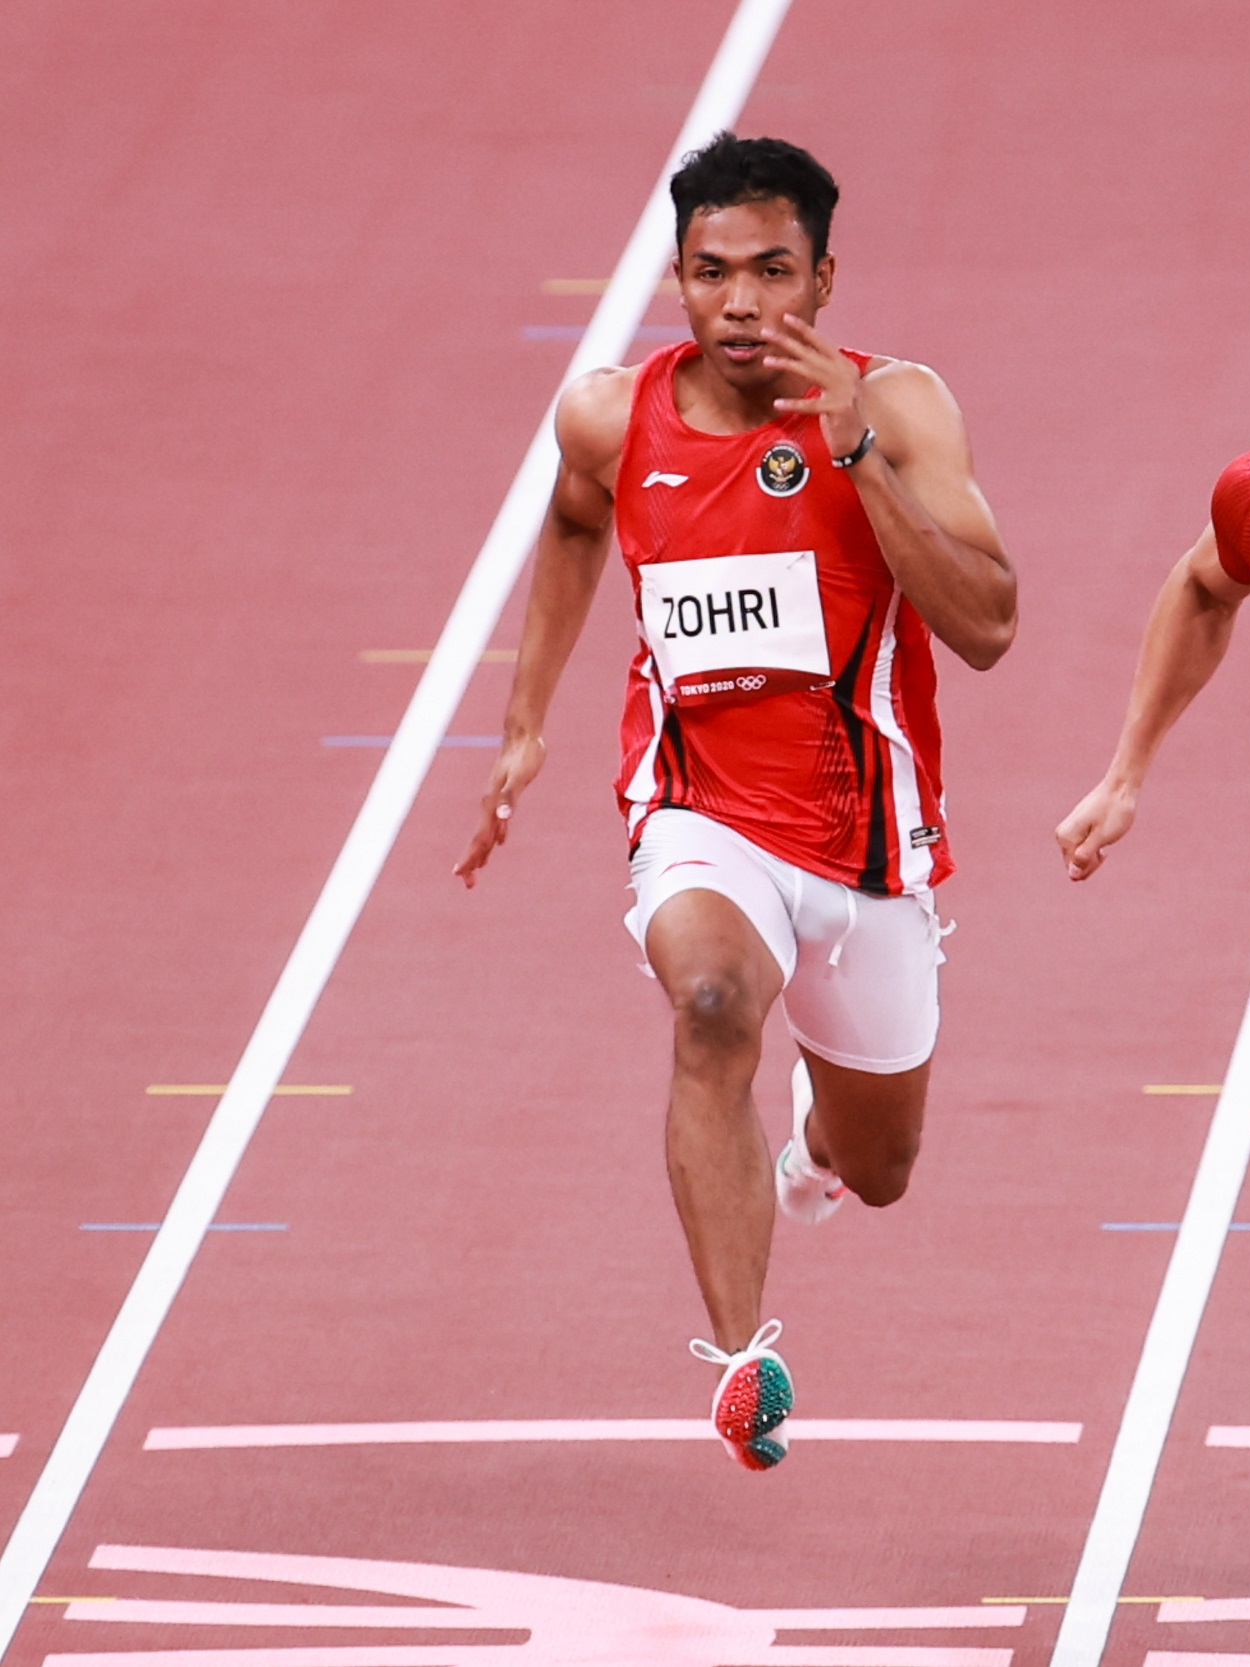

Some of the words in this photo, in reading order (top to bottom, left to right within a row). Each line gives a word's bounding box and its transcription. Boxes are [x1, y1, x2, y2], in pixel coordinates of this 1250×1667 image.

[661, 586, 781, 639] ZOHRI
[680, 683, 710, 696] TOKYO
[710, 680, 735, 693] 2020
